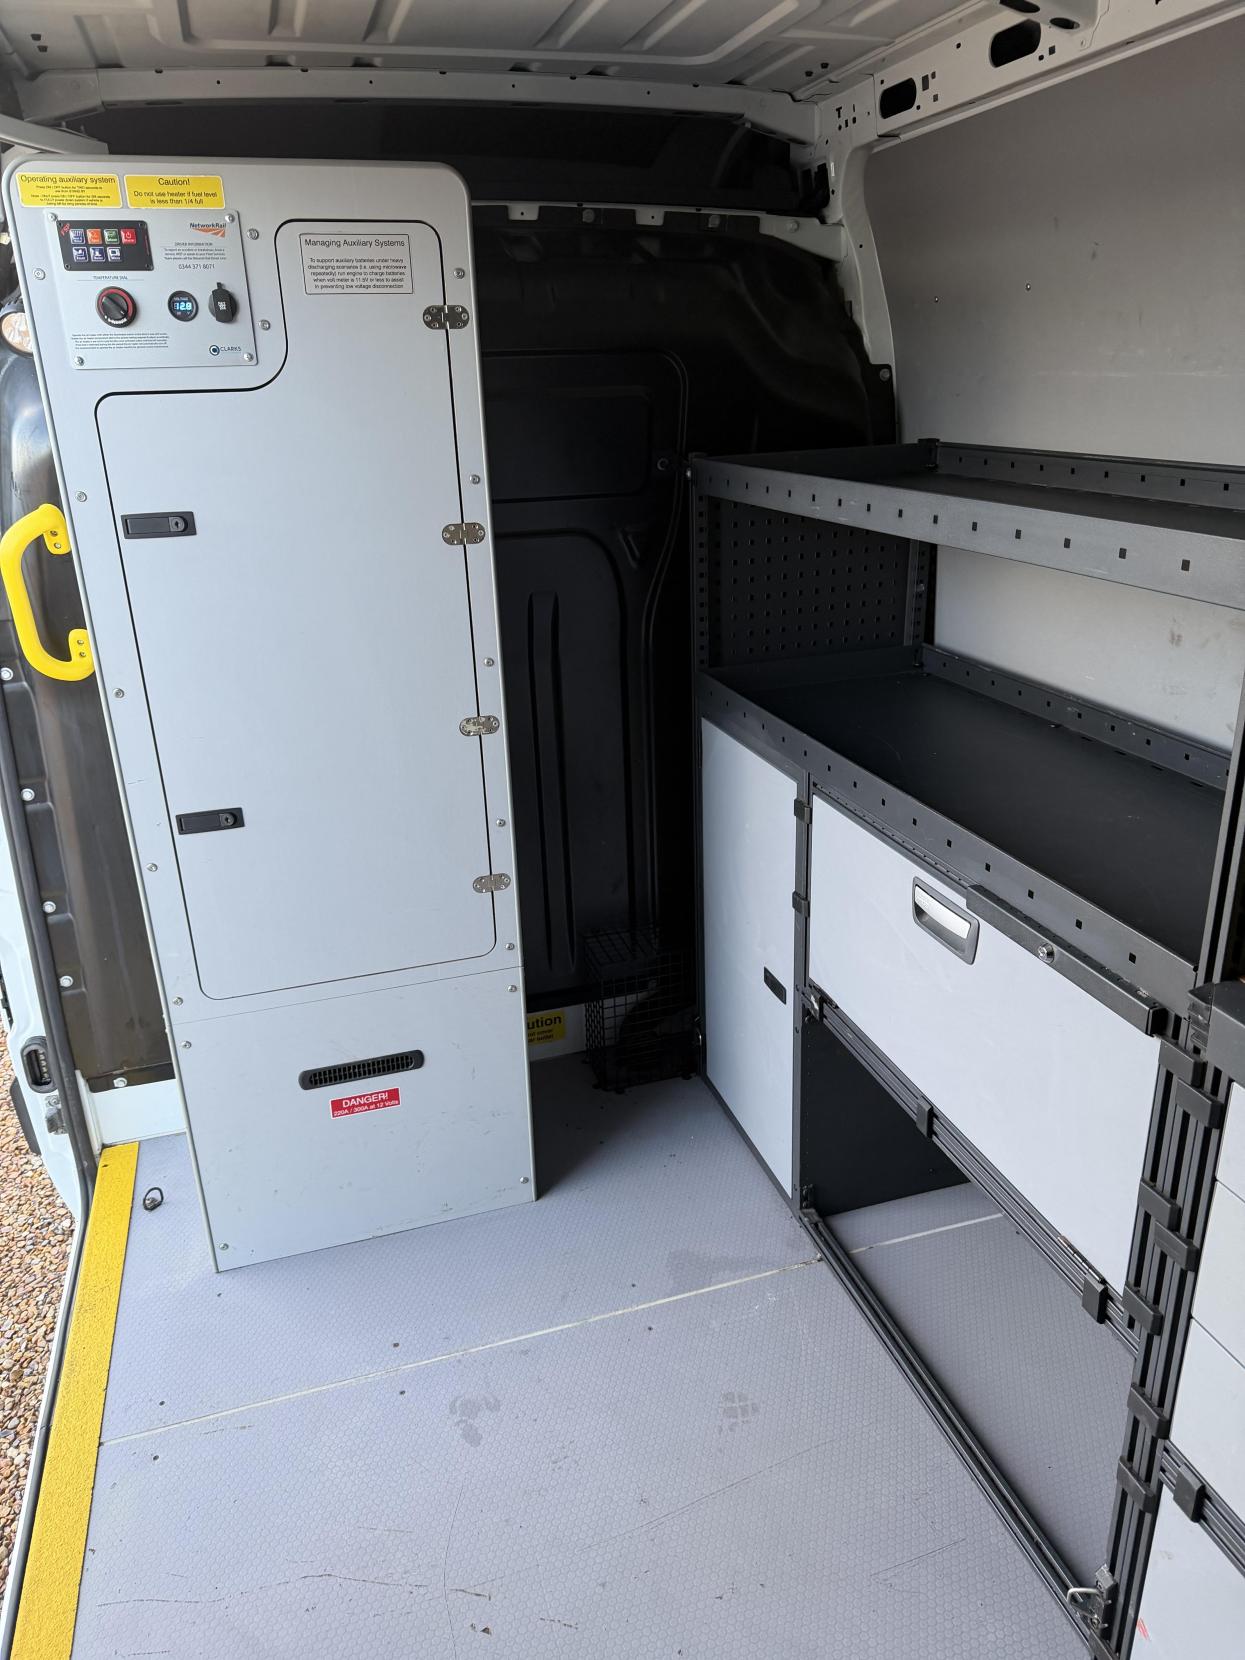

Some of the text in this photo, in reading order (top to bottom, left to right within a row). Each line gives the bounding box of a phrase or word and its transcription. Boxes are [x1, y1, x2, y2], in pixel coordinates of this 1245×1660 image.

[20, 174, 57, 184] Operating
[59, 175, 88, 184] auxiliary
[158, 178, 190, 186] Caution!
[305, 239, 405, 248] Managing Auxiliary Systems
[527, 1016, 562, 1030] ution
[342, 1092, 388, 1108] DANGER!
